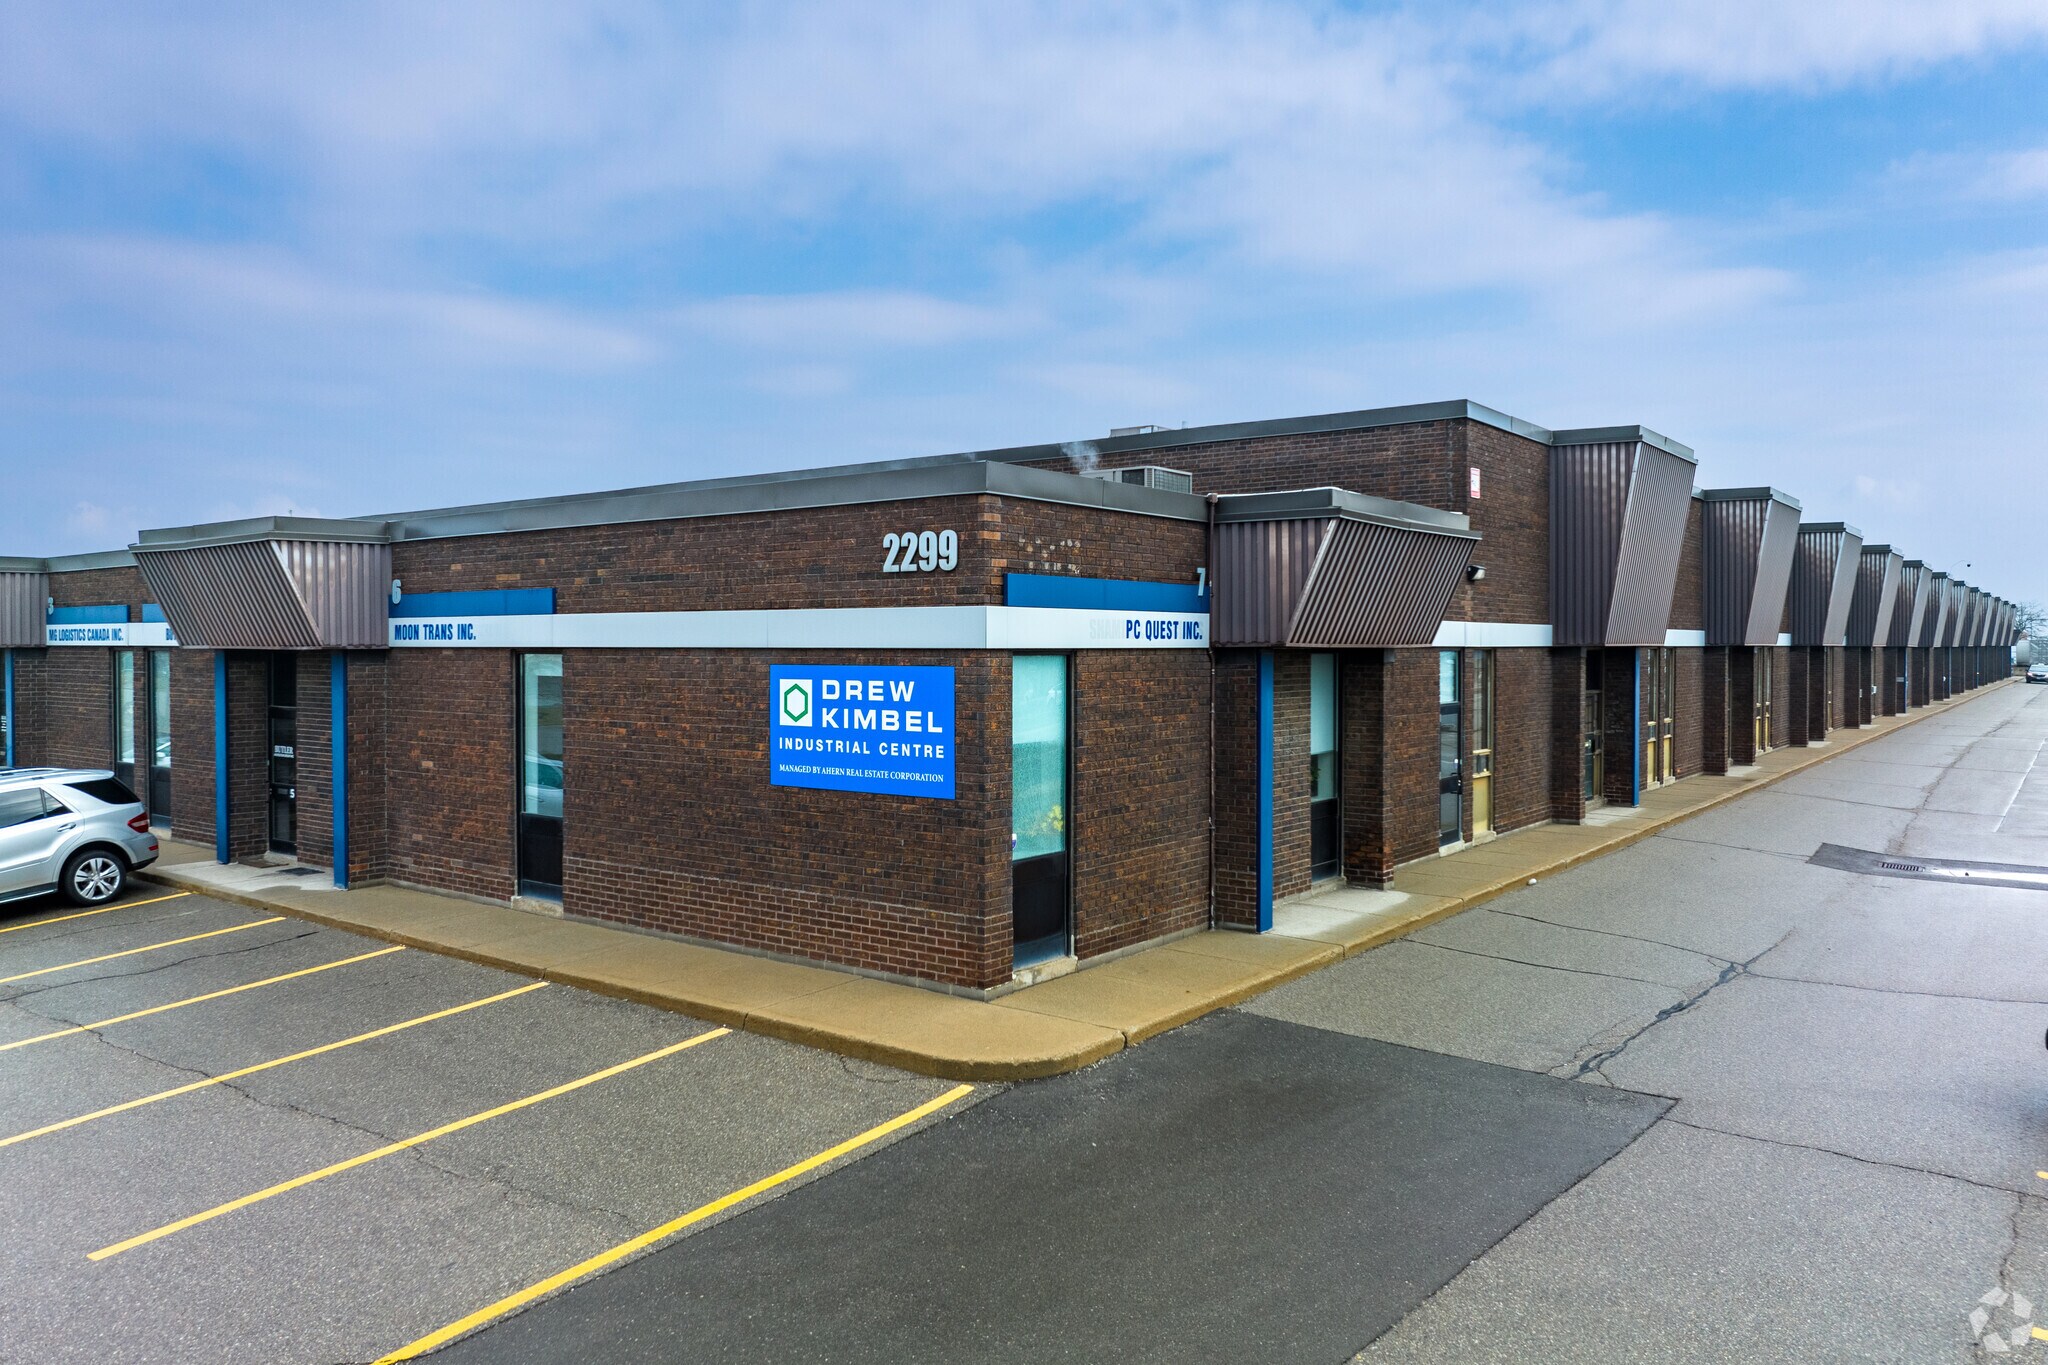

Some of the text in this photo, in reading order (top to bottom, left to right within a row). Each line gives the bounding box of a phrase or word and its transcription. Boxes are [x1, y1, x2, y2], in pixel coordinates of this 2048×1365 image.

[883, 529, 958, 573] 2299
[392, 579, 402, 605] 6
[1196, 567, 1206, 597] 7
[47, 597, 54, 615] 3
[48, 628, 124, 642] MG LOGISTICS CANADA INC.
[394, 623, 477, 641] MOON TRANS INC.
[1125, 619, 1203, 641] PC QUEST INC.
[821, 679, 915, 702] DREW
[821, 708, 943, 733] KIMBEL
[779, 737, 945, 759] INDUSTRIAL CENTRE
[779, 764, 944, 783] MANAGED BY AHERN REAL ESTATE CORPORATION
[290, 789, 295, 799] 5
